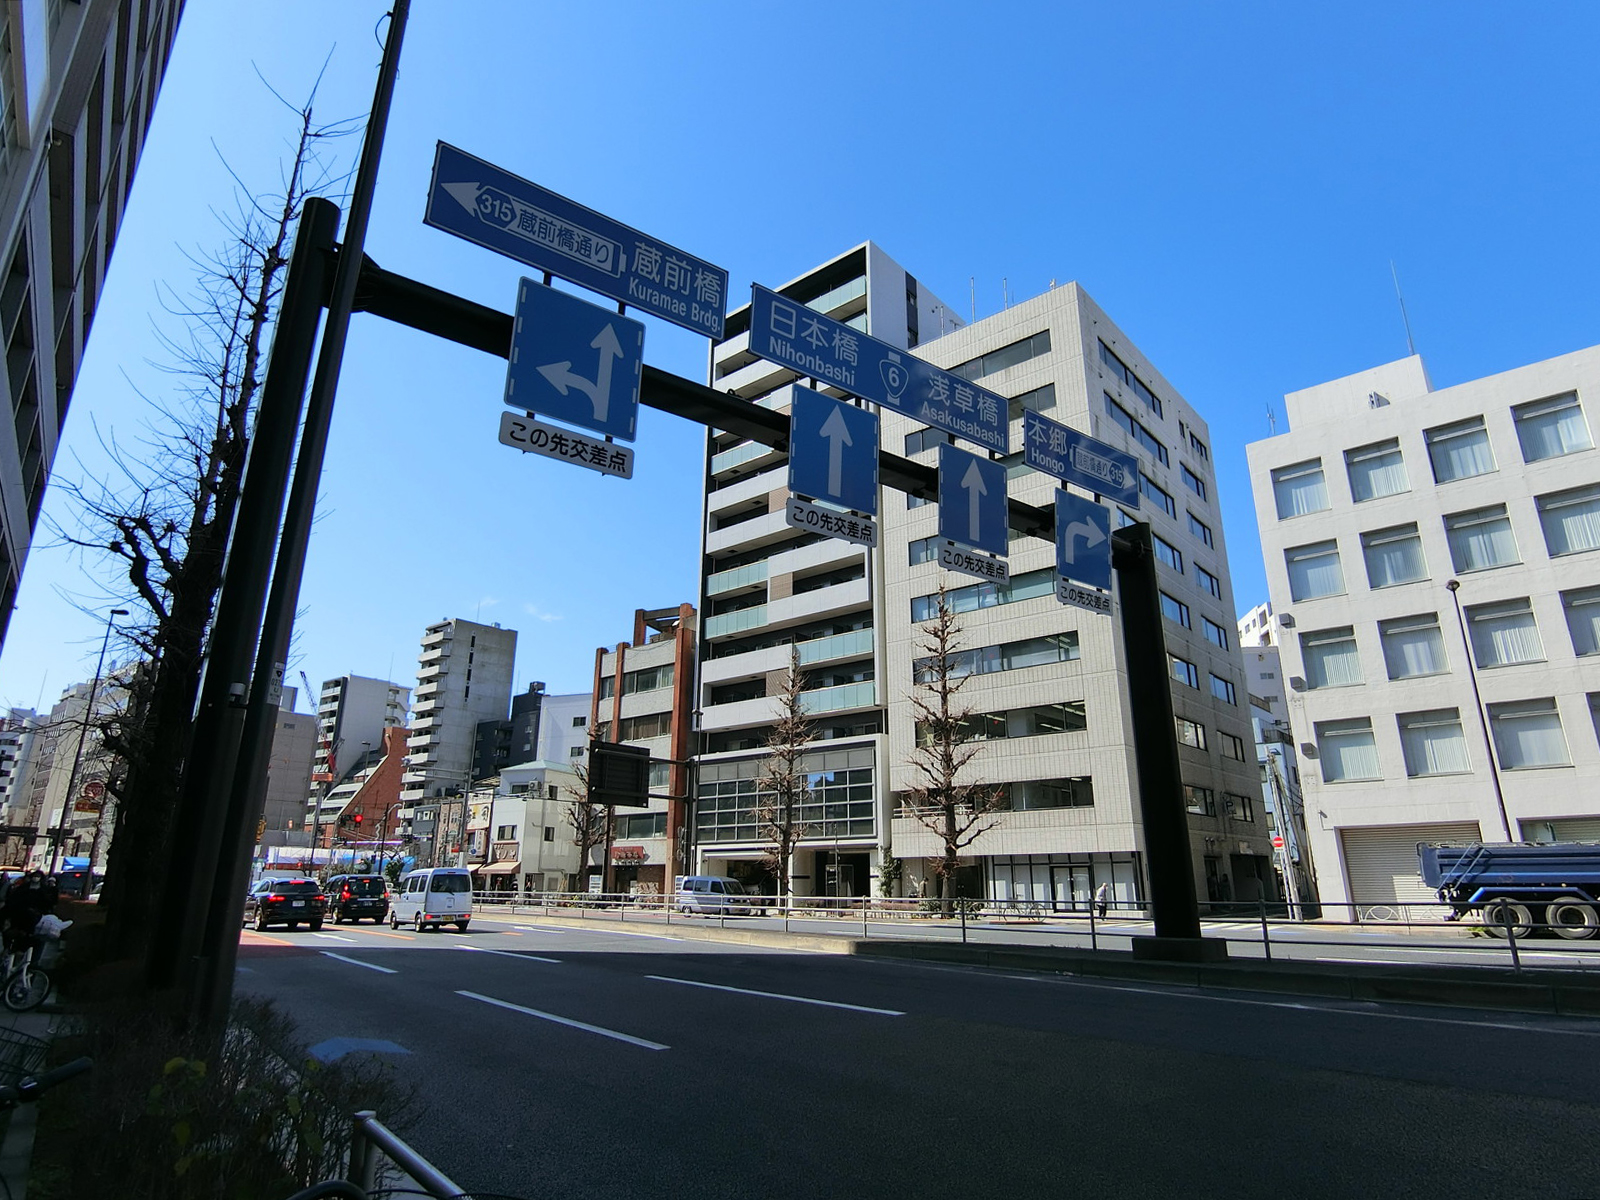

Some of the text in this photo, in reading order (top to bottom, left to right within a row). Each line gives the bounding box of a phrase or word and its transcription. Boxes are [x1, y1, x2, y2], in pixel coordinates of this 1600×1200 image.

[481, 194, 512, 222] 315
[517, 209, 609, 264] 蔵前橋通り
[631, 241, 721, 308] 蔵前橋
[629, 277, 721, 332] Kuramae Brdg.
[770, 301, 859, 367] 日本橋
[769, 336, 855, 386] Nihonbashi
[888, 368, 900, 387] 6
[928, 372, 999, 427] 浅草橋
[921, 401, 1005, 448] Asakusabashi
[1028, 419, 1067, 456] 本郷
[509, 422, 627, 473] この先交差点
[1032, 447, 1065, 473] Hongo
[1110, 466, 1123, 483] 315
[792, 505, 873, 542] この先交差点
[943, 549, 1006, 580] この先交差点
[1061, 586, 1111, 612] この先交差点
